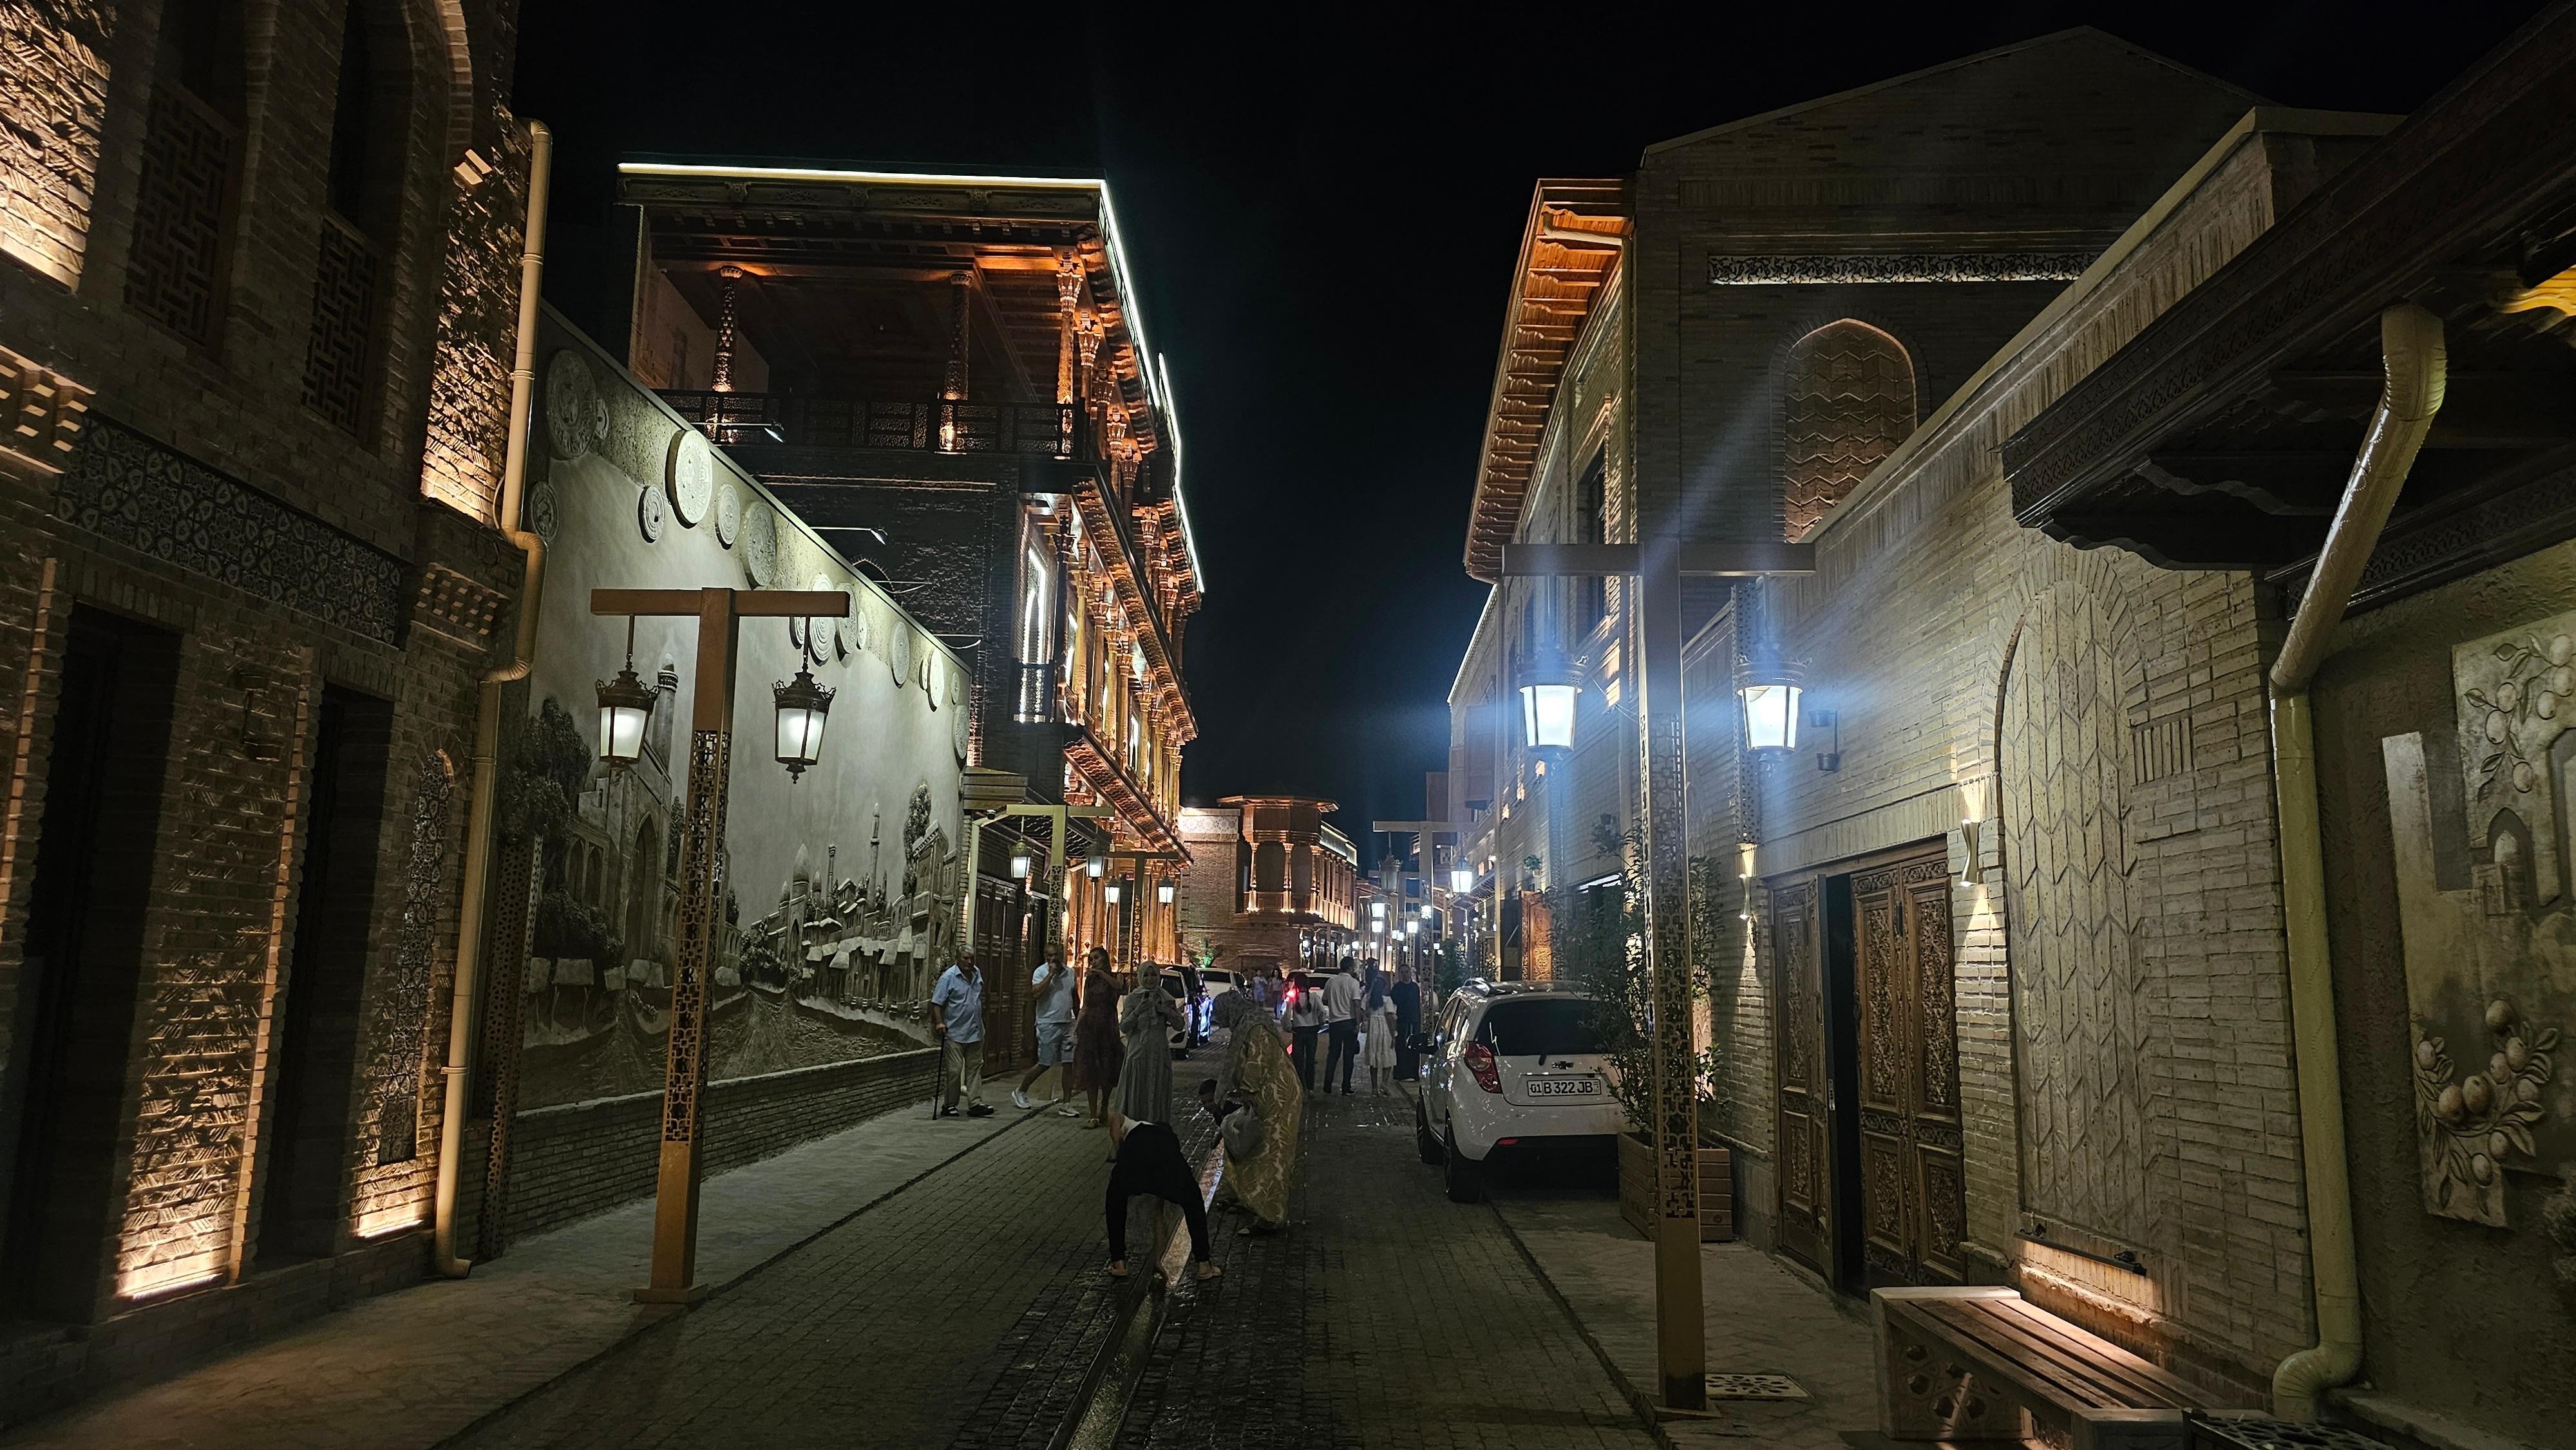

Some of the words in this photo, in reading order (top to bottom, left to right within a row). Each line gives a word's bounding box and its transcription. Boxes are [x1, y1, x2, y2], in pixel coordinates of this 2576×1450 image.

[1530, 1084, 1542, 1093] 01
[1544, 1082, 1552, 1094] B
[1553, 1082, 1575, 1094] 322
[1577, 1081, 1593, 1093] JB
